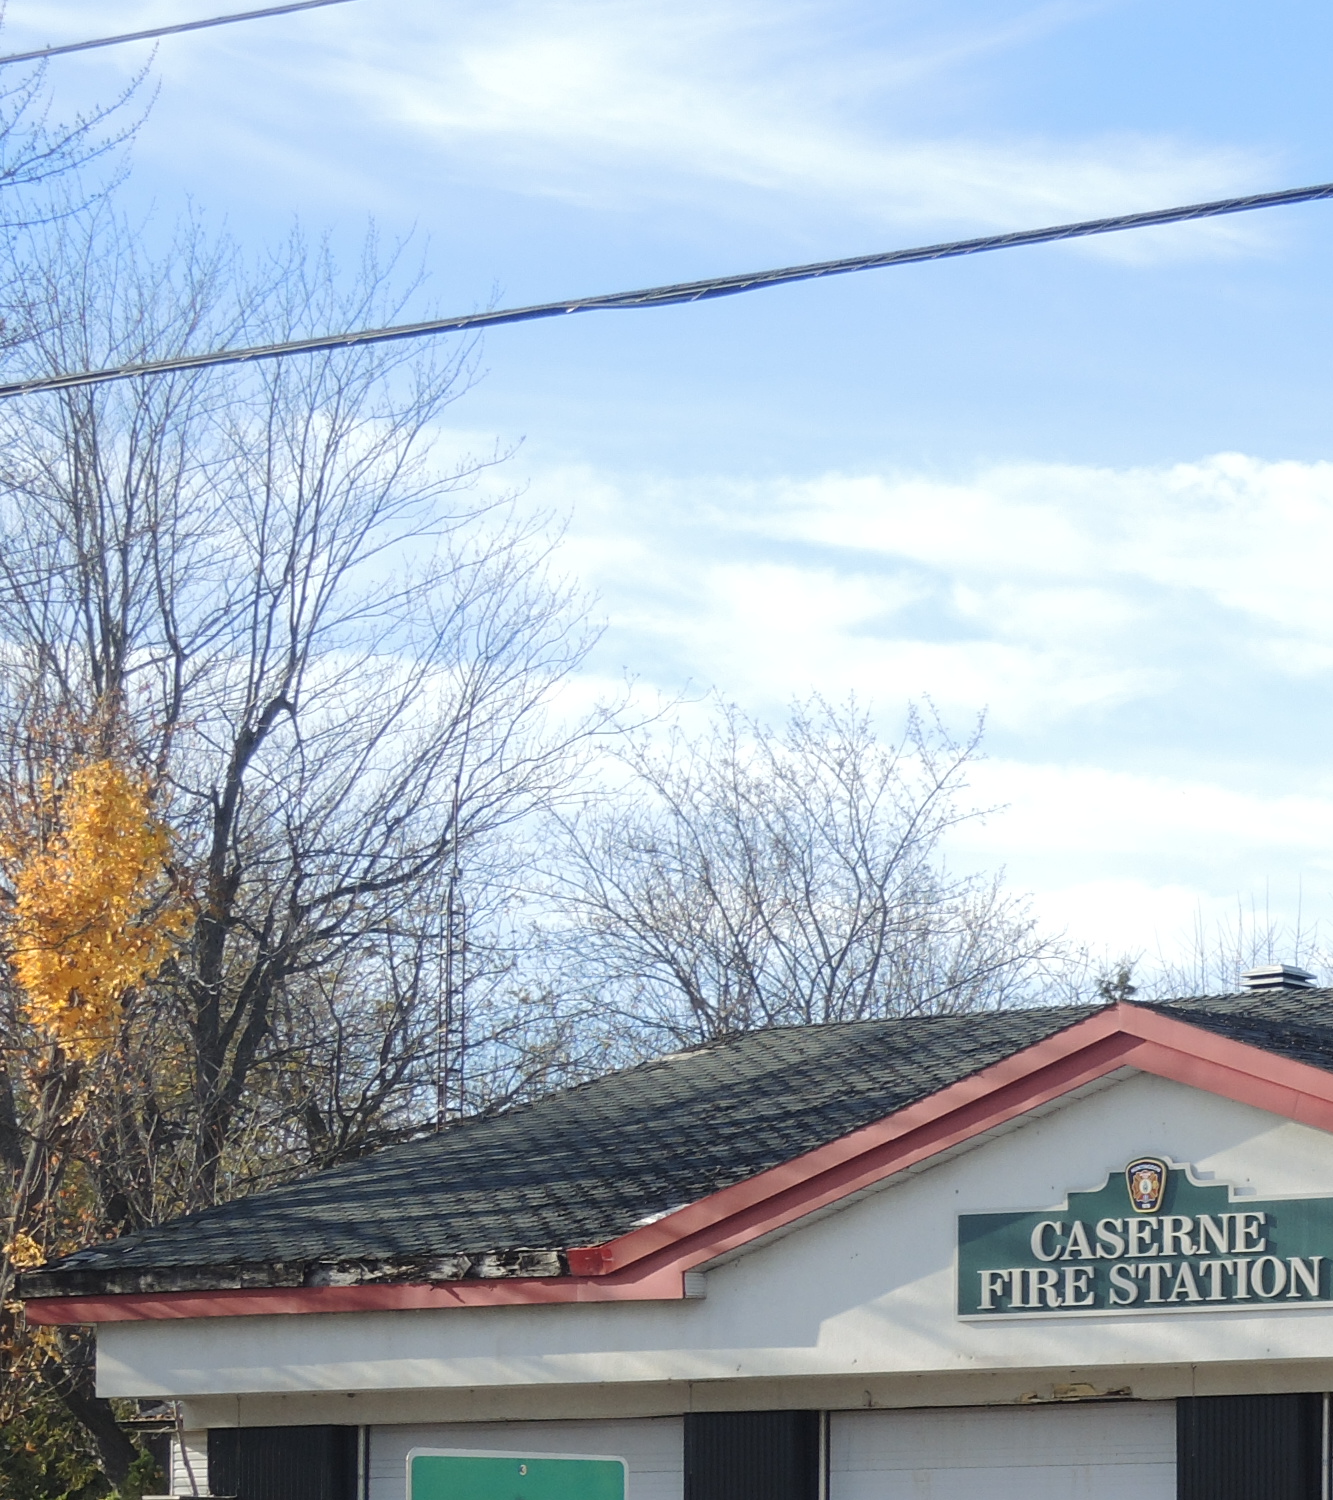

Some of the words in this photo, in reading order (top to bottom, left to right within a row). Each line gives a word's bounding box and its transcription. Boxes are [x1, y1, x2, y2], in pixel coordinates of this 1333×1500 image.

[1030, 1211, 1268, 1262] CASERNE
[976, 1265, 1096, 1309] FIRE
[1109, 1256, 1325, 1305] STATION
